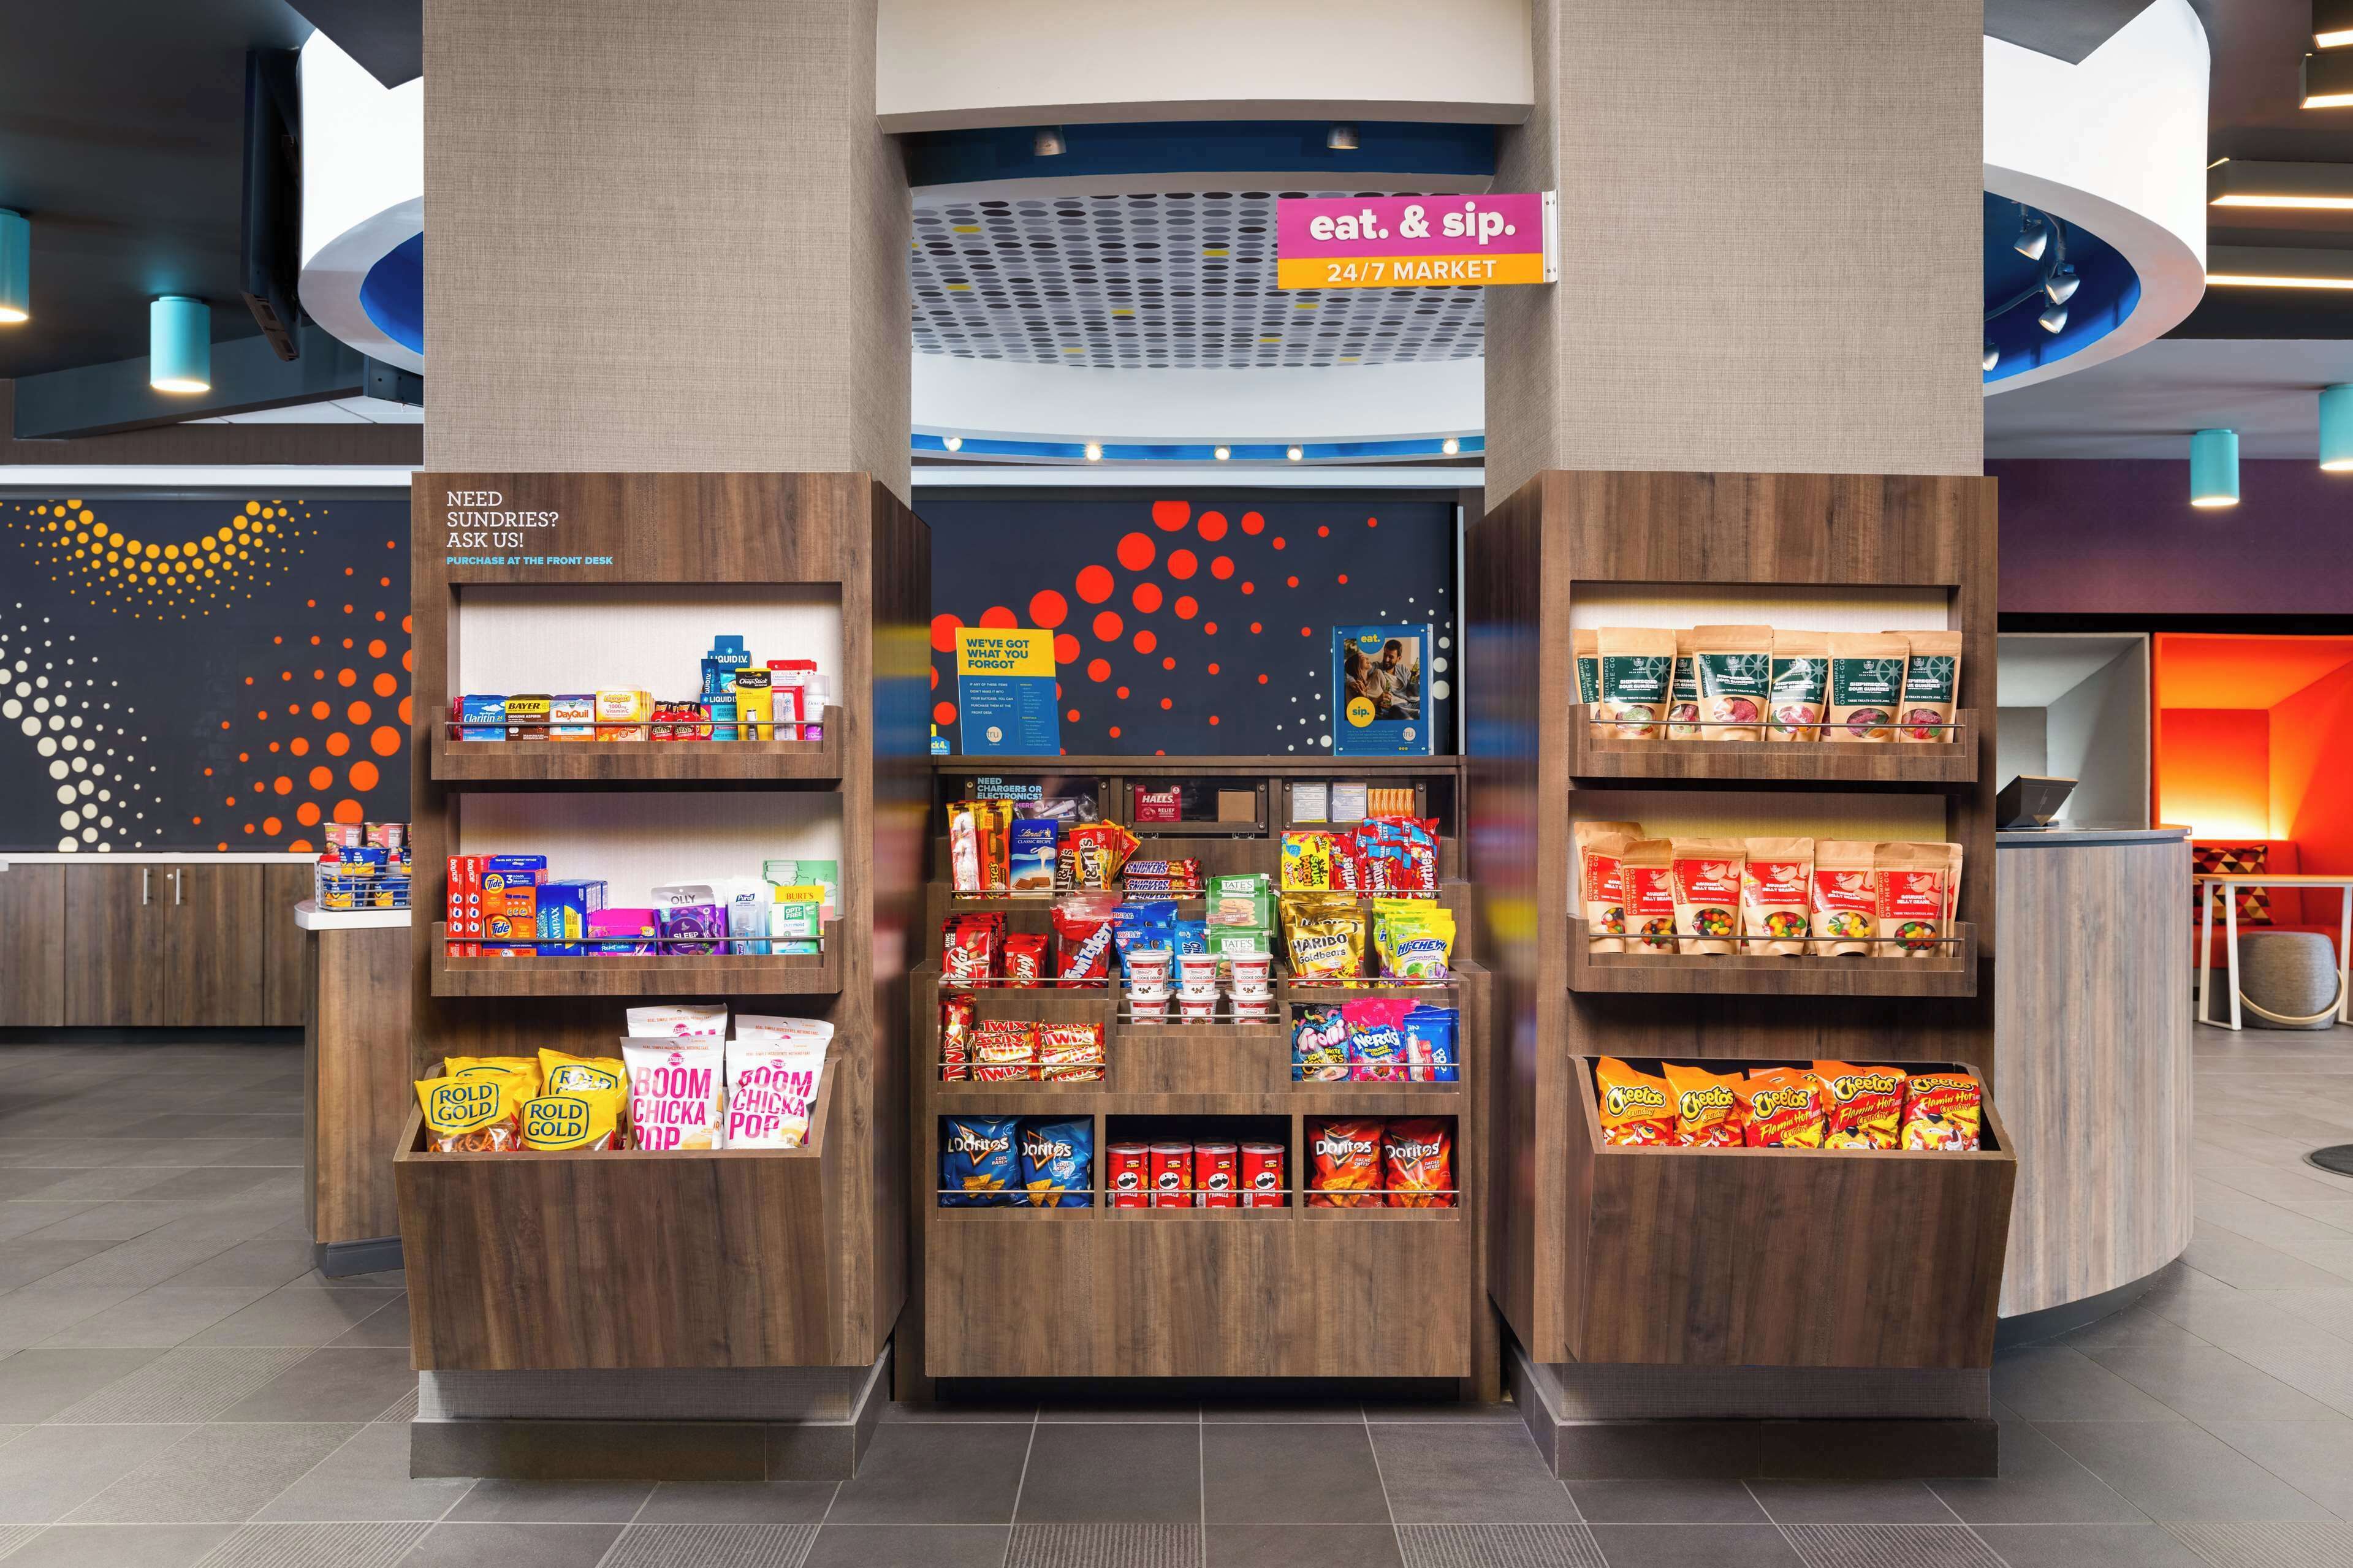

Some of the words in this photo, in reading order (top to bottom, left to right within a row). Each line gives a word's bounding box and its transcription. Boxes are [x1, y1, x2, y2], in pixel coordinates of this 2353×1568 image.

[1310, 209, 1388, 240] eat.
[1399, 205, 1430, 238] &
[1442, 202, 1516, 245] sip.
[1328, 262, 1385, 282] 24/7
[1394, 260, 1497, 280] MARKET
[447, 491, 502, 506] NEED
[447, 512, 559, 527] SUNDRIES?
[447, 532, 488, 547] ASK
[493, 532, 523, 547] US!
[968, 660, 1014, 668] FORGOT
[464, 714, 495, 722] Claritin
[556, 710, 588, 719] DayQuil
[1352, 706, 1369, 717] sip.
[1127, 865, 1168, 874] SNICKERS
[1300, 855, 1313, 886] PATCH
[1310, 855, 1321, 884] SOUR
[487, 879, 502, 891] Tide
[506, 875, 512, 884] 3
[671, 895, 695, 904] OLLY
[492, 922, 510, 936] Tide
[1292, 933, 1348, 953] HARIBO
[1397, 939, 1446, 956] HI-CHEW
[1298, 949, 1346, 964] Goldbears
[982, 1021, 1028, 1031] TWIX
[1298, 1019, 1345, 1051] Trolli
[634, 1067, 712, 1099] BOOM
[737, 1066, 813, 1098] BOOM
[1833, 1074, 1897, 1102] Cheetos
[1910, 1078, 1974, 1093] Cheetos
[439, 1085, 492, 1104] ROLD
[1606, 1085, 1665, 1117] Cheetos
[1753, 1085, 1809, 1120] Cheetos
[1920, 1095, 1955, 1111] Flamin'
[1956, 1088, 1974, 1101] Hot
[732, 1089, 805, 1118] CHICKA
[1679, 1085, 1736, 1121] Cheetos
[1839, 1102, 1876, 1124] Flamin'
[1876, 1097, 1893, 1109] Hot
[1940, 1103, 1971, 1114] Crunchy
[438, 1102, 492, 1121] GOLD
[530, 1104, 582, 1120] ROLD
[633, 1099, 706, 1126] CHICKA
[1625, 1107, 1655, 1118] Crunchy
[1701, 1109, 1727, 1123] Crunchy
[1795, 1110, 1809, 1124] Hot
[1857, 1111, 1888, 1125] Crunchy
[528, 1122, 582, 1137] GOLD
[729, 1112, 779, 1140] POP
[1781, 1124, 1808, 1141] Crunchy
[633, 1125, 680, 1149] POP
[948, 1137, 1009, 1152] Doritos
[1317, 1140, 1372, 1156] Doritos
[1386, 1143, 1439, 1159] Doritos
